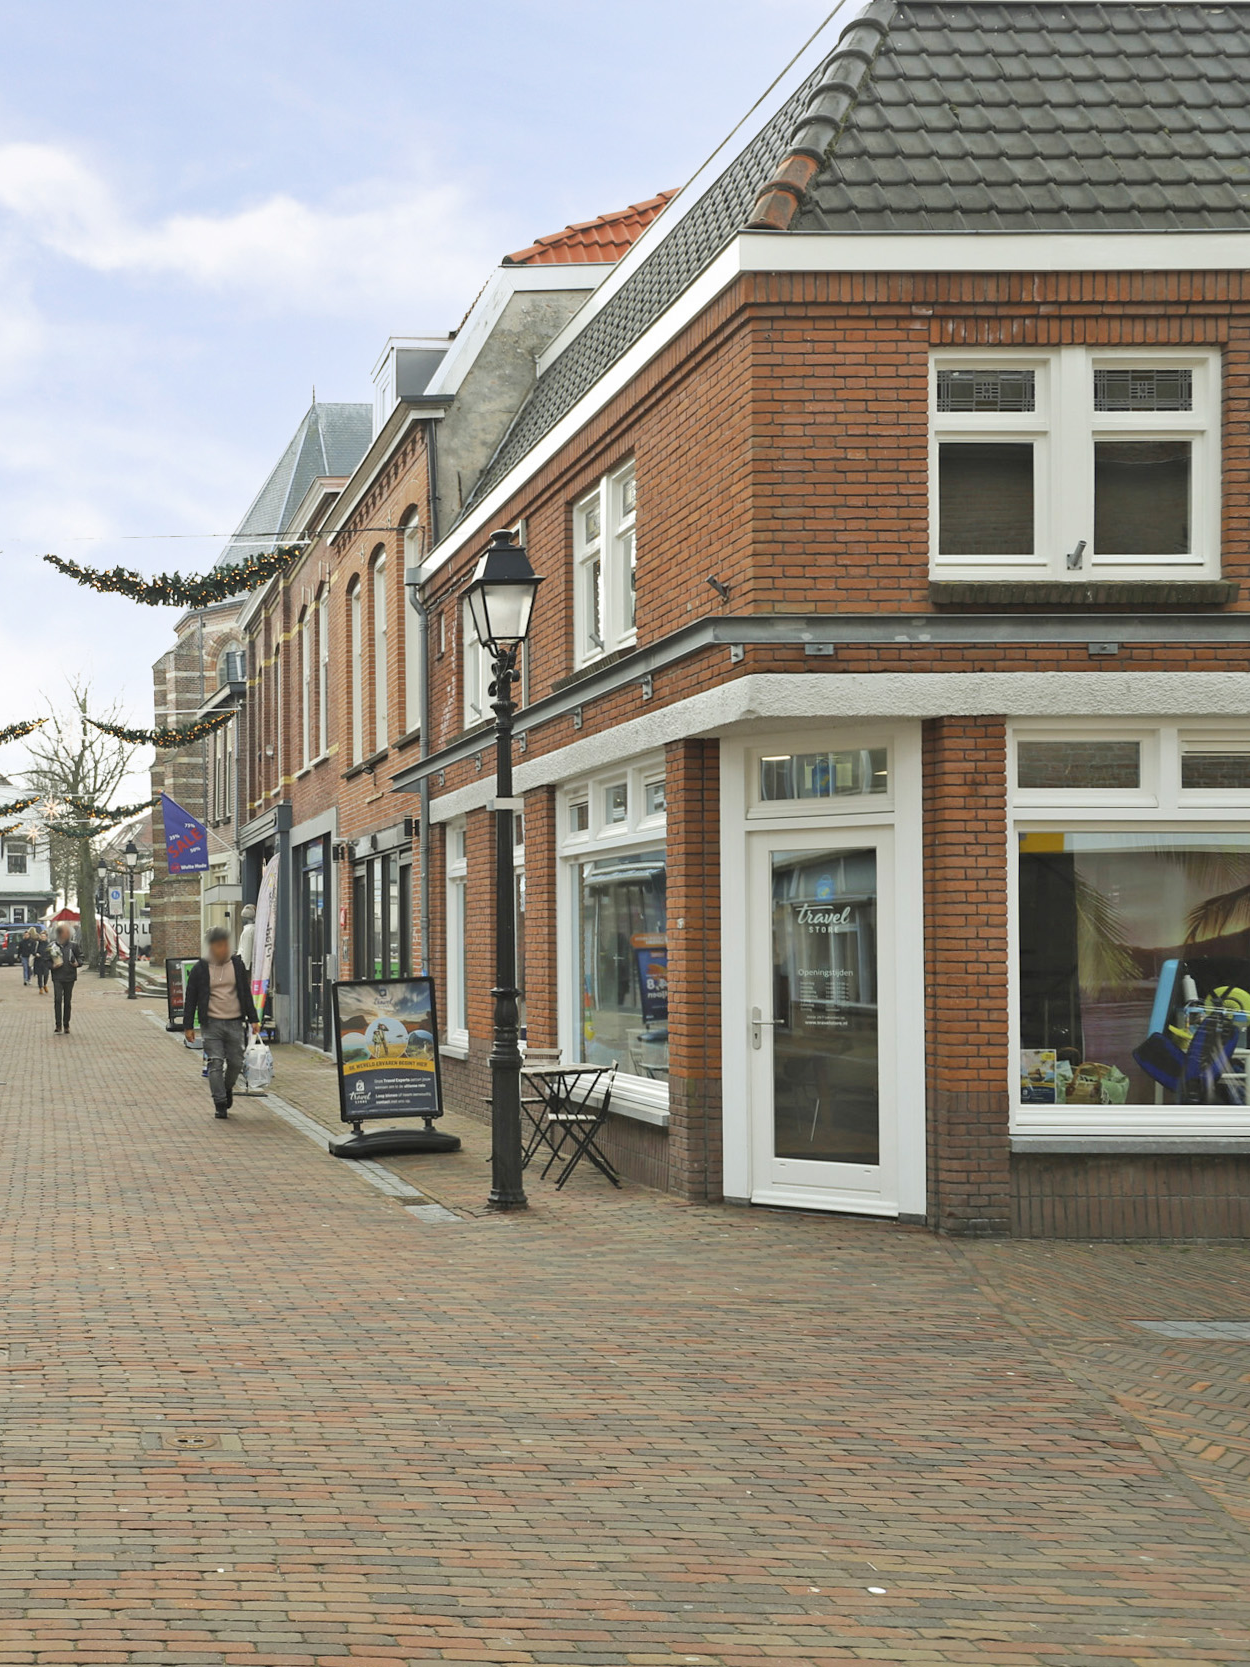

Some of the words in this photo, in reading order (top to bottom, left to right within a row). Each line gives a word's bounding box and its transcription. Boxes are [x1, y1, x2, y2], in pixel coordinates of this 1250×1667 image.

[168, 828, 204, 858] SALE
[795, 903, 850, 924] travel
[798, 968, 854, 978] Openingstijden
